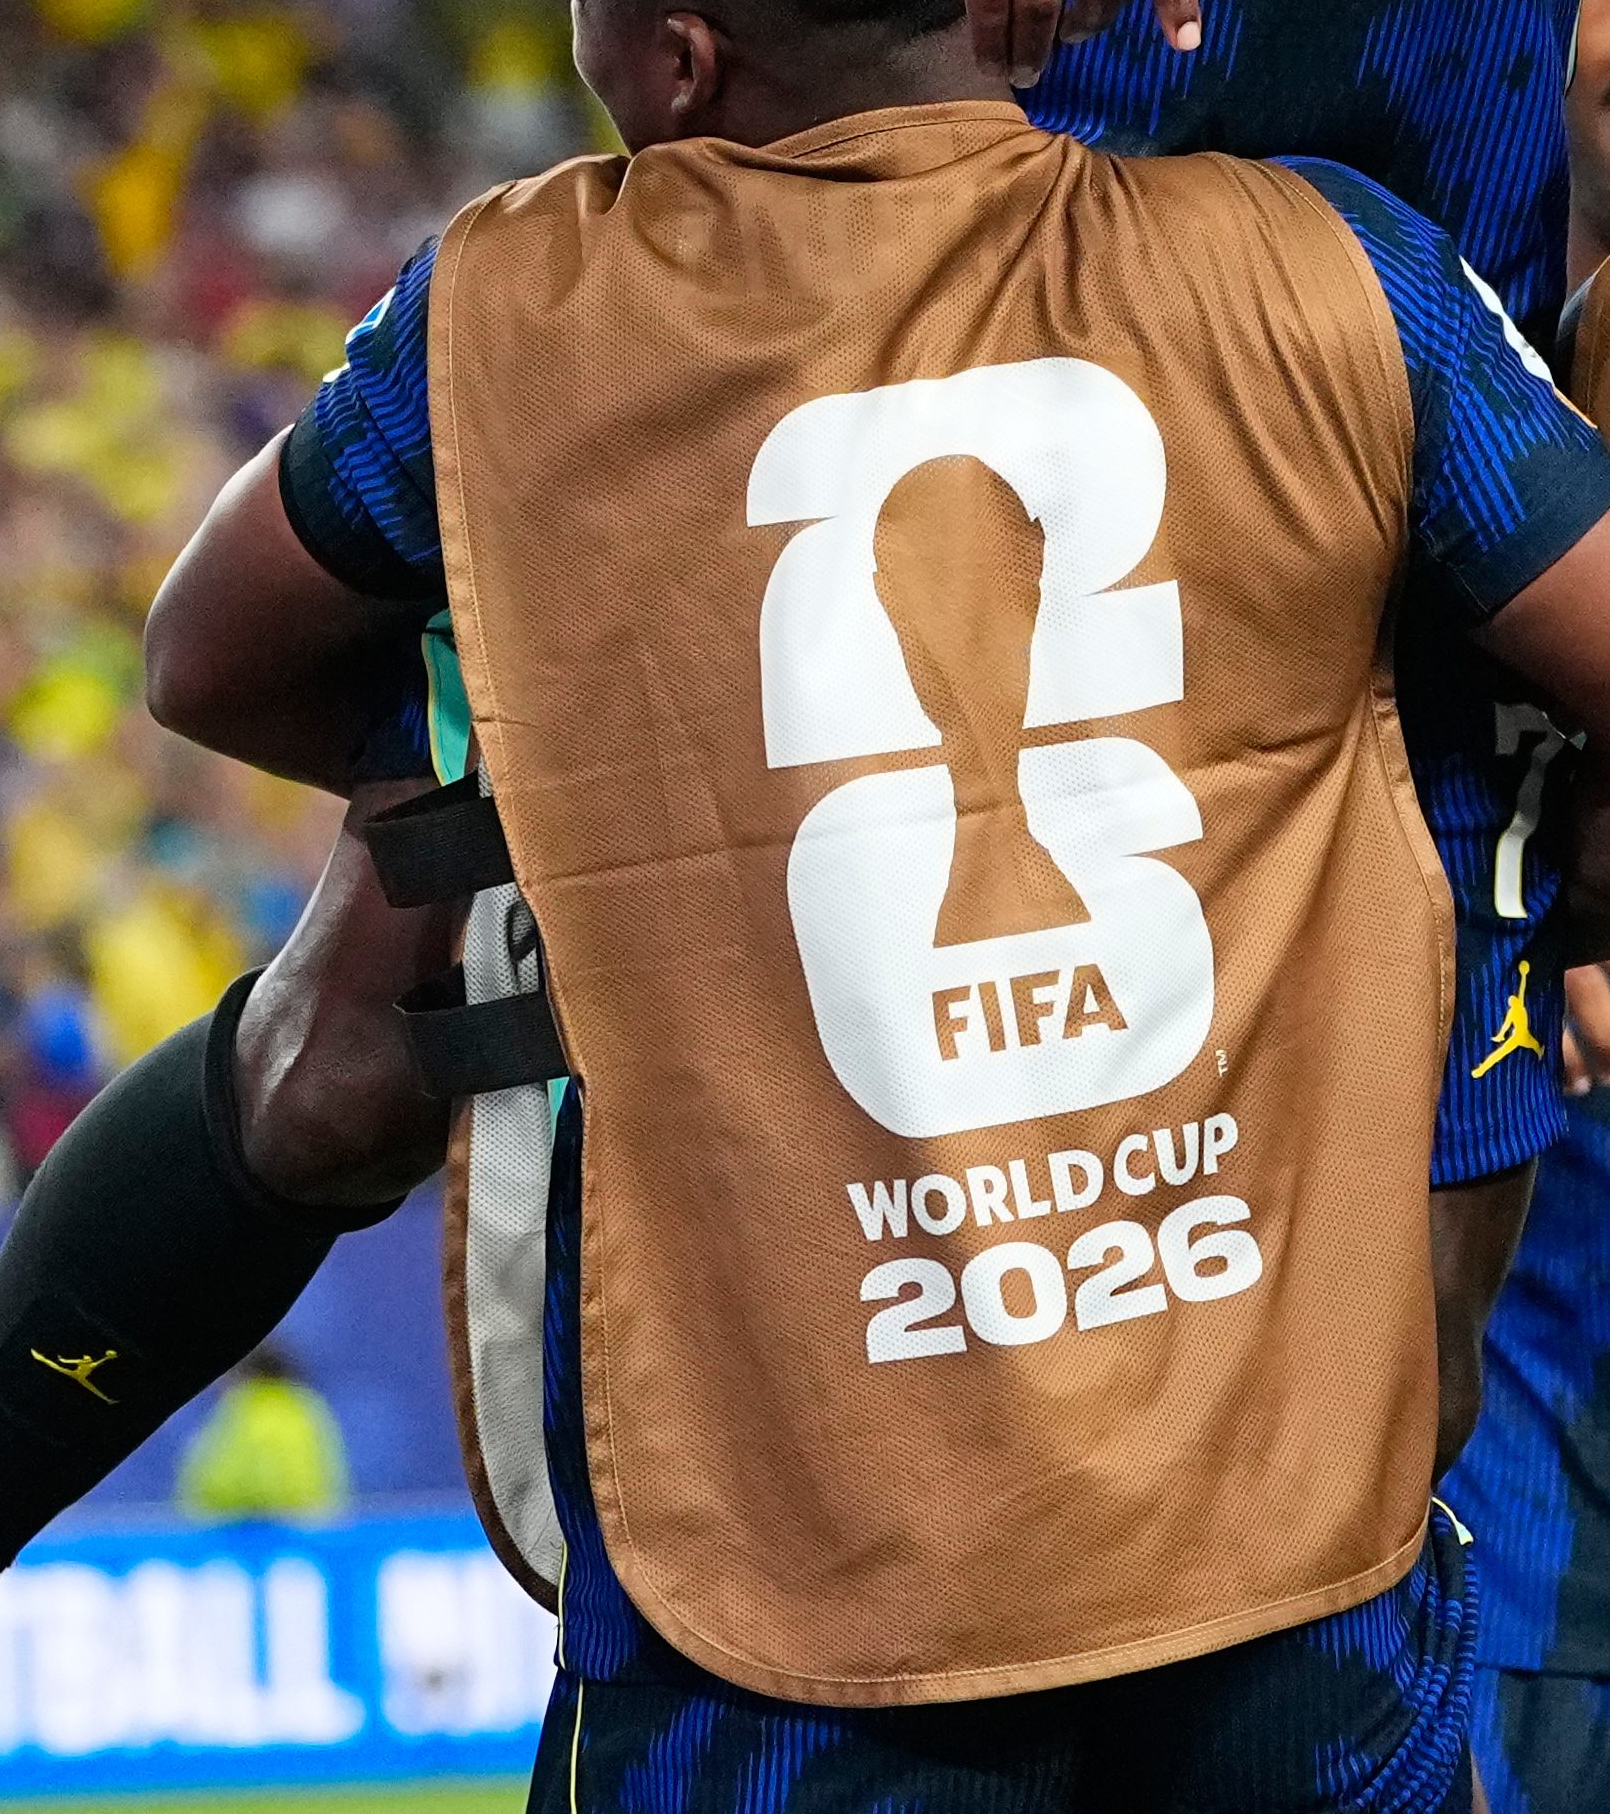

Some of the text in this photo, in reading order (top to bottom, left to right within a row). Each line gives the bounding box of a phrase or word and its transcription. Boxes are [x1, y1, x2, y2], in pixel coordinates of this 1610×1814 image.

[931, 964, 1128, 1061] FIFA
[847, 1113, 1238, 1241] WORLD CUP
[860, 1195, 1262, 1363] 2026
